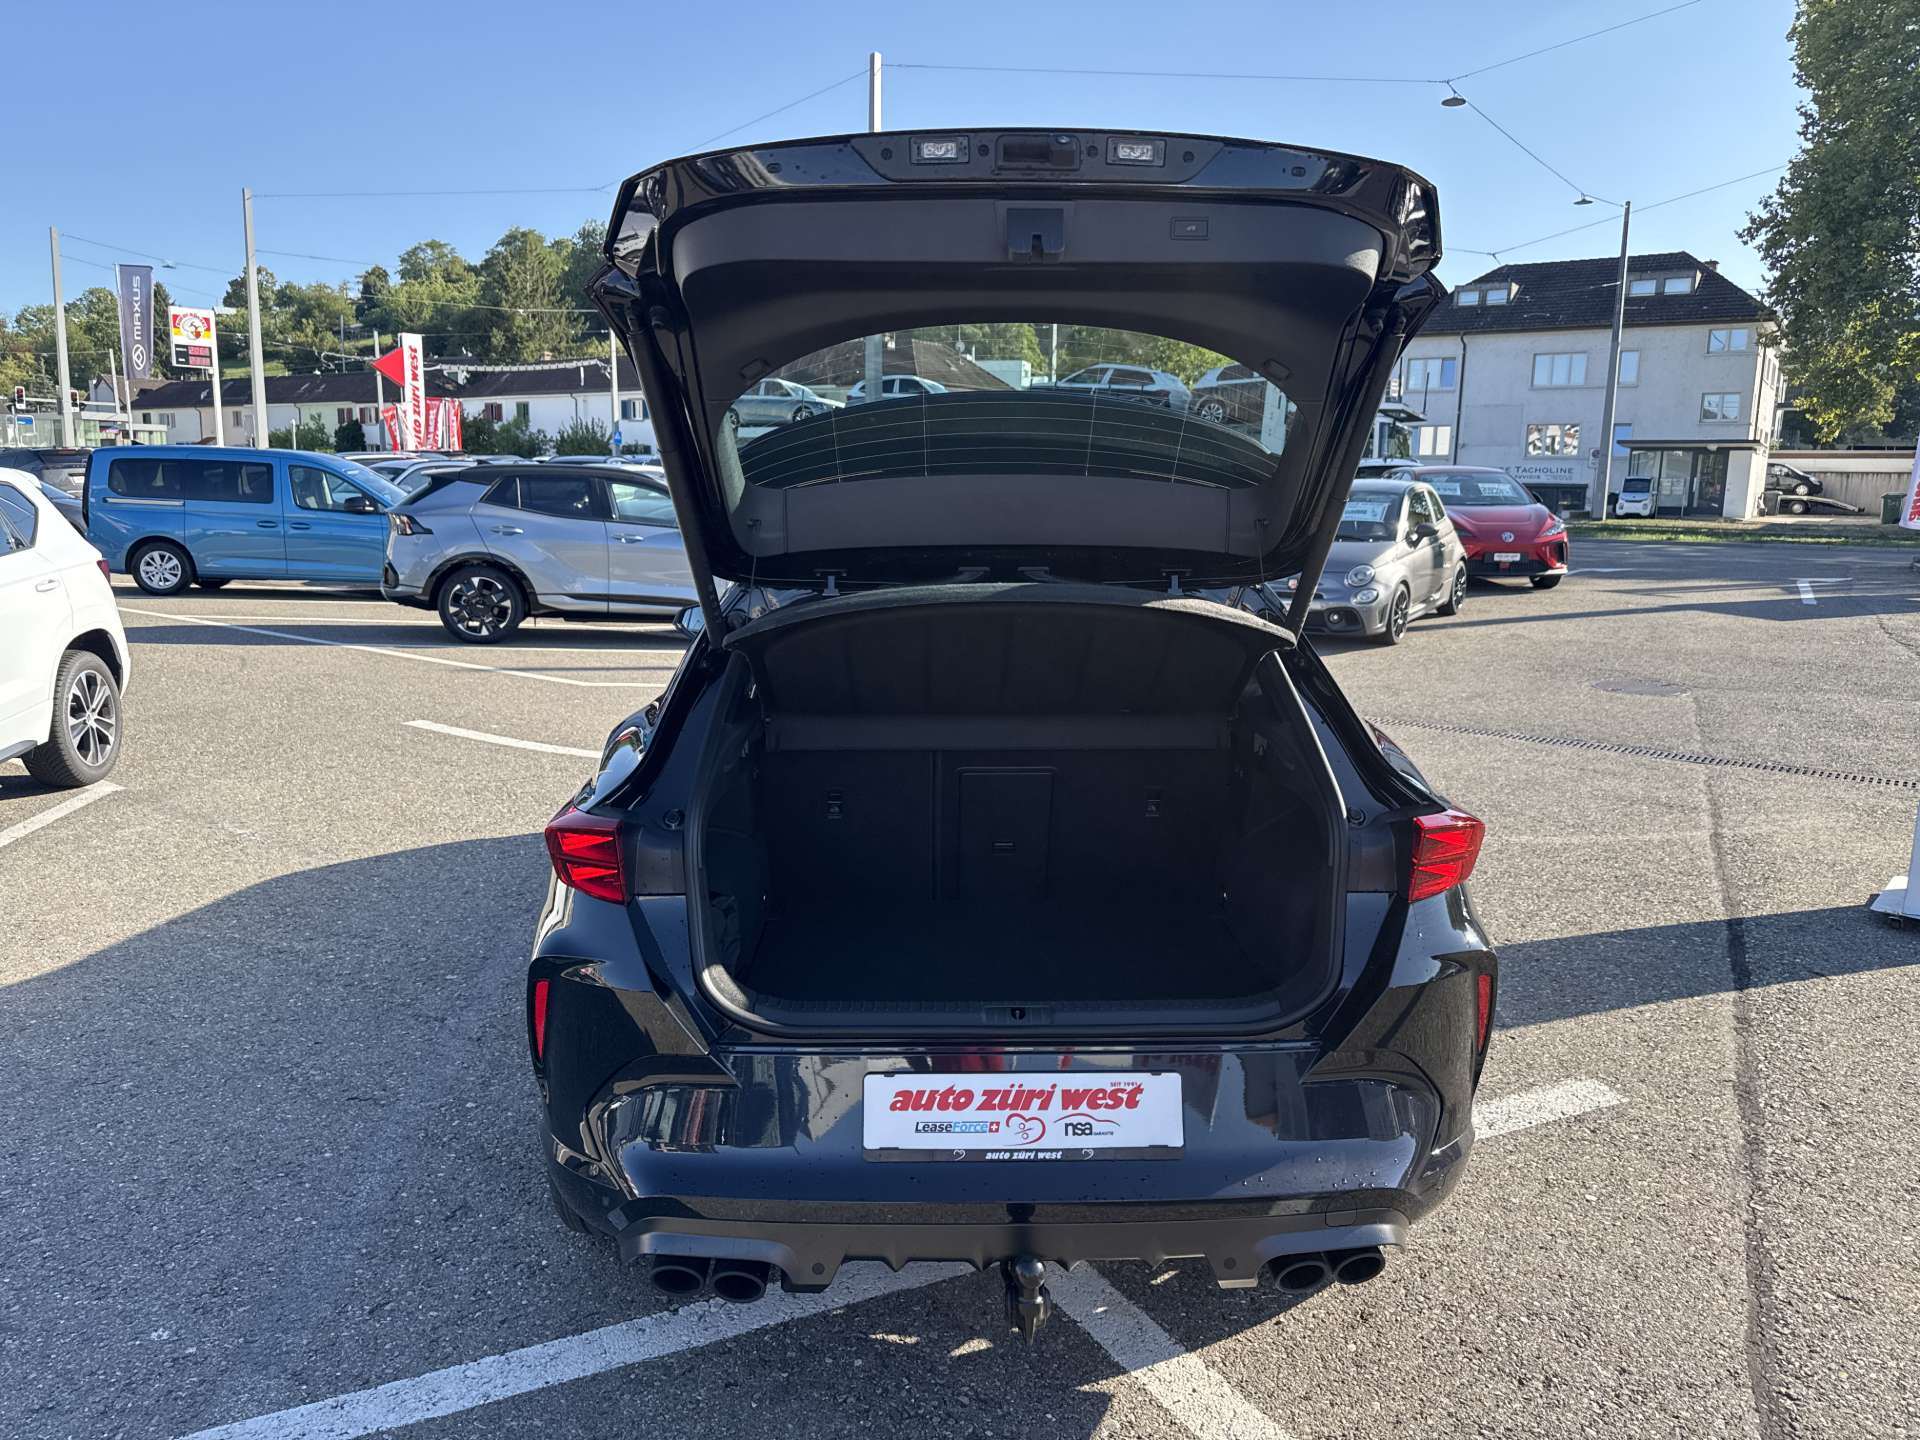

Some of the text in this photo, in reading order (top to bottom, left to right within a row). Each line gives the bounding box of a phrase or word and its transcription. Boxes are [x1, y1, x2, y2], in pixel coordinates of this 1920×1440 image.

[133, 275, 142, 340] MAXUS
[408, 345, 419, 382] west
[1514, 466, 1575, 475] TACHOLINE
[889, 1082, 1145, 1112] auto züri west
[915, 1121, 988, 1134] LeaseForce
[1064, 1122, 1093, 1137] nsa
[985, 1150, 1063, 1160] auto züri west
